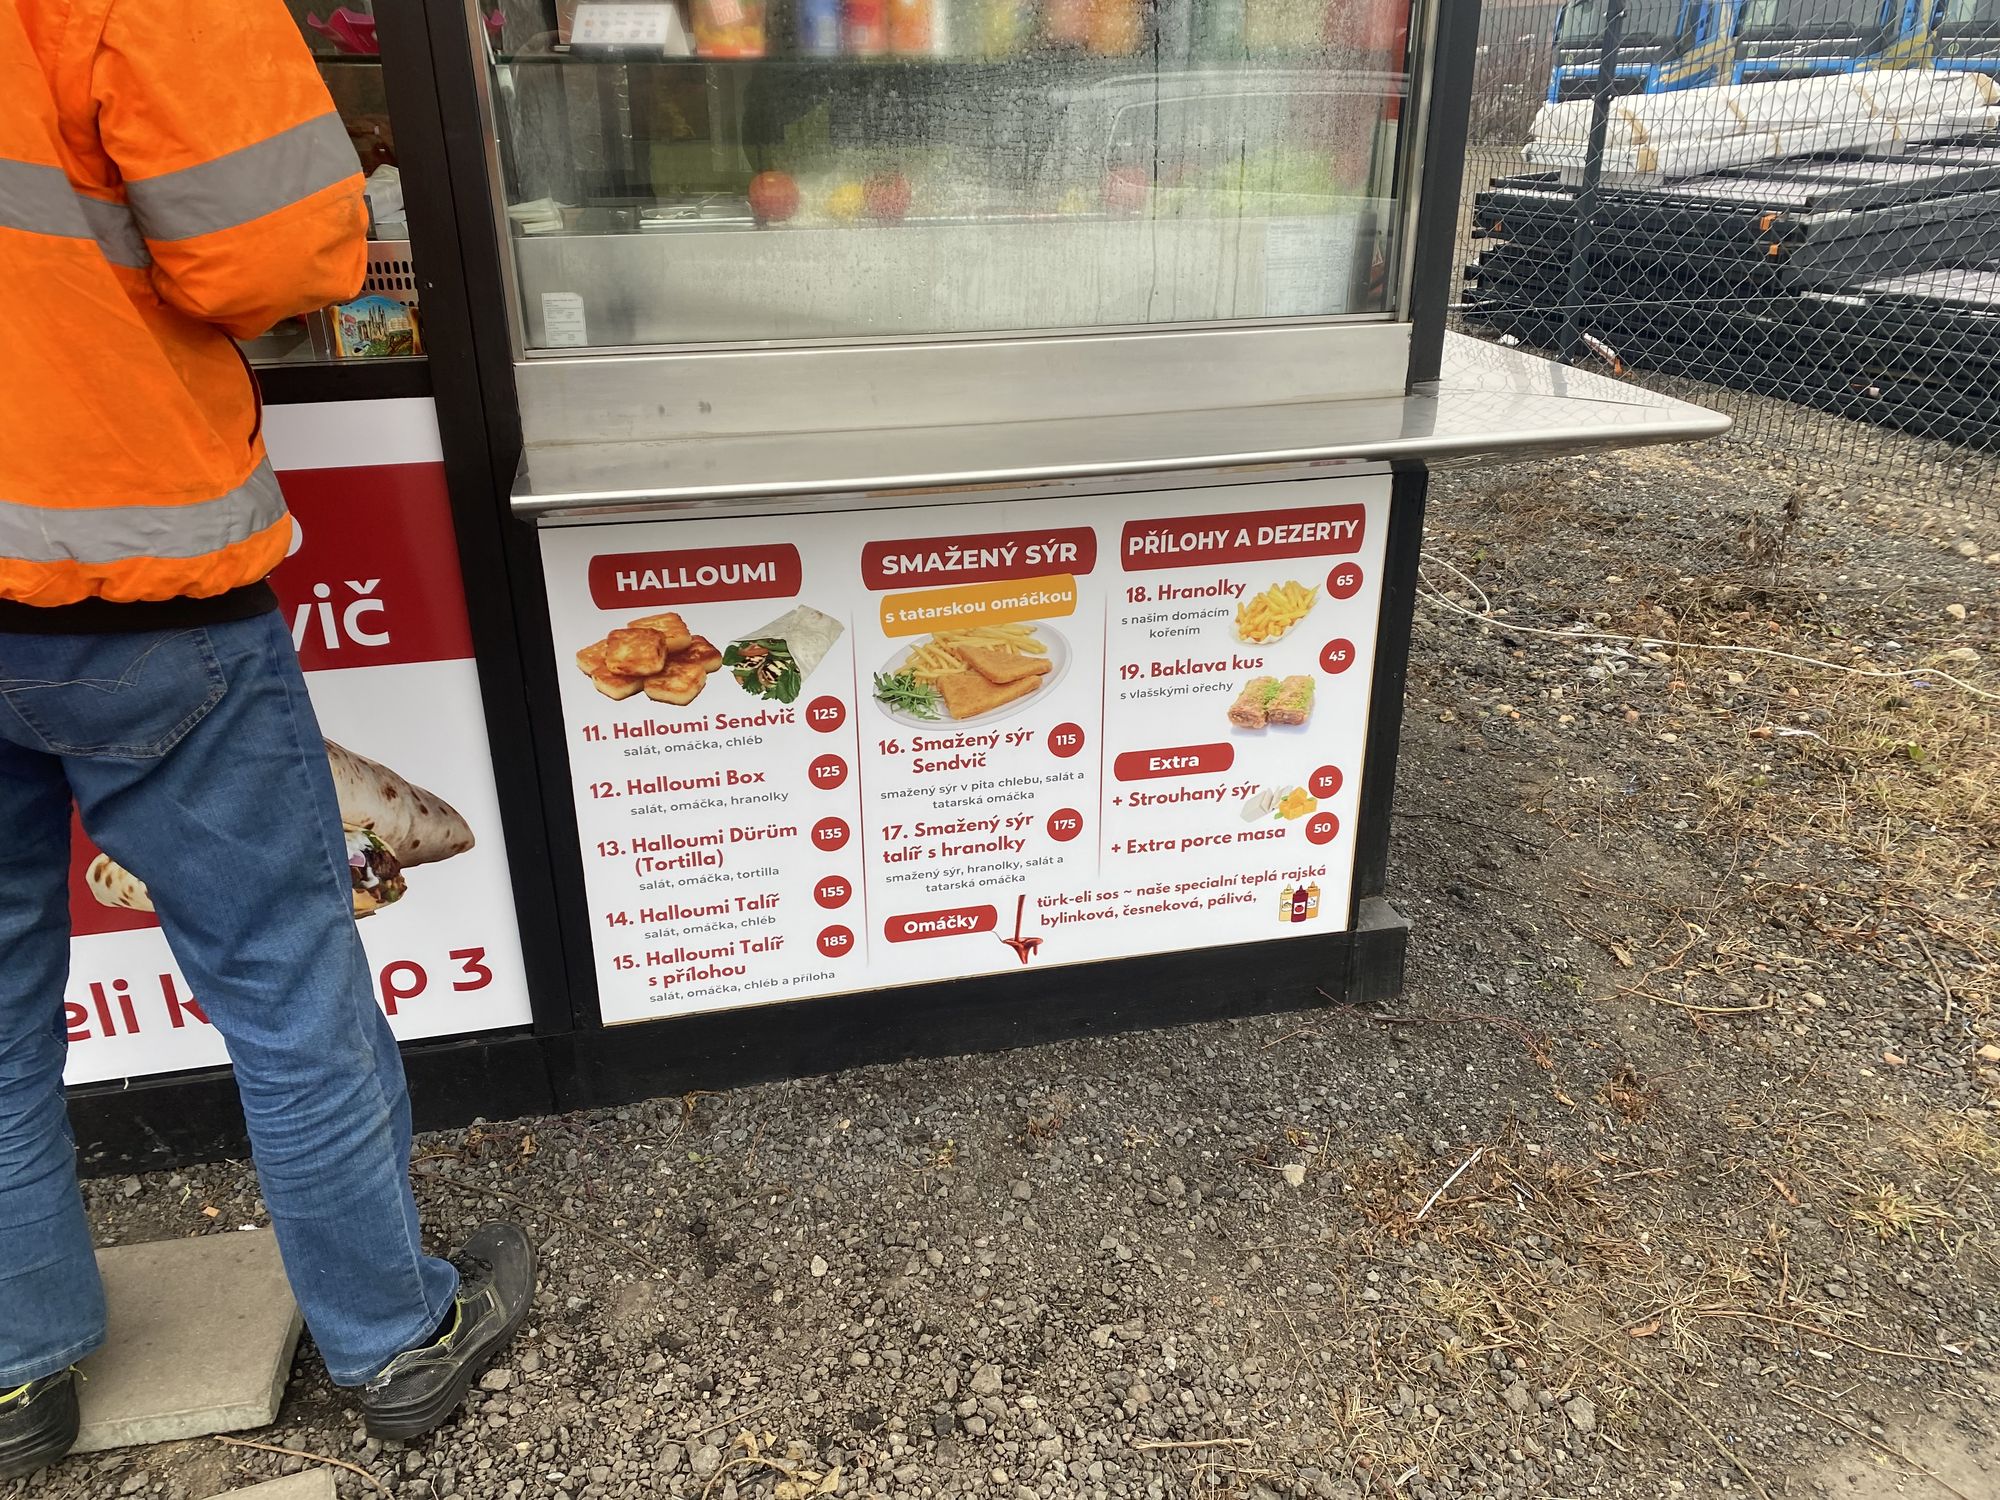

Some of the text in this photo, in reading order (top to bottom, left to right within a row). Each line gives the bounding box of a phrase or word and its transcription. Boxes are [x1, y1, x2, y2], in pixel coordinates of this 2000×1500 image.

[1128, 519, 1359, 556] PŘÍLOHY A DEZERTY
[882, 538, 1078, 575] SMAŽENÝ SÝR
[615, 561, 777, 592] HALLOUMI
[1336, 574, 1354, 586] 65
[1126, 578, 1247, 603] 18. Hranolky
[885, 591, 1072, 623] s tatarskou omáčkou
[1121, 607, 1229, 626] s našim domácím
[1149, 625, 1200, 639] kořením
[1119, 654, 1264, 680] 19. Baklava kus
[1329, 650, 1346, 662] 45
[1120, 681, 1233, 700] s vlašskými ořechy
[582, 707, 795, 742] 11. Halloumi Sendvič
[812, 707, 838, 721] 125
[623, 735, 763, 757] salát, omáčka, chléb
[878, 727, 1035, 755] 16. Smažený sýr
[1056, 734, 1077, 745] 115
[815, 765, 840, 778] 125
[911, 752, 987, 774] Sendvič
[1149, 755, 1200, 771] Extra
[589, 769, 766, 799] 12. Halloumi Box
[880, 785, 936, 800] smažený
[938, 782, 958, 795] sýr
[960, 783, 969, 791] v
[971, 780, 995, 793] pita
[998, 775, 1043, 788] chlebu,
[1045, 771, 1074, 783] salát
[1112, 780, 1260, 808] + Strouhaný sýr
[1318, 776, 1333, 787] 15
[630, 791, 789, 817] salát, omáčka, hranolky
[932, 791, 1035, 809] tatarská omáčka
[818, 827, 843, 840] 135
[882, 812, 1034, 841] 17. Smažený sýr
[1053, 818, 1076, 830] 175
[1314, 823, 1331, 834] 50
[596, 824, 797, 858] 13. Halloumi Dürüm
[882, 835, 1026, 864] talíř s hranolky
[1111, 826, 1286, 855] + Extra porce masa
[635, 849, 724, 877] (Tortilla)
[885, 869, 940, 884] smažený
[942, 864, 964, 877] sýr,
[967, 861, 1023, 874] hranolky,
[1025, 856, 1054, 867] salát
[639, 867, 780, 892] salát, omáčka, tortilla
[820, 885, 844, 898] 155
[925, 874, 1026, 893] tatarská omáčka
[1037, 890, 1093, 909] türk-eli
[1095, 889, 1120, 901] sos
[1136, 881, 1171, 897] naše
[1174, 875, 1238, 894] specialní
[1241, 870, 1278, 886] teplá
[1281, 865, 1326, 883] rajská
[605, 892, 780, 928] 14. Halloumi Talíř
[1040, 890, 1257, 928] bylinková, česneková, pálivá,
[644, 915, 776, 940] salát, omáčka, chléb
[903, 913, 979, 934] Omáčky
[612, 936, 785, 971] 15. Halloumi Talíř
[823, 935, 848, 947] 185
[448, 946, 493, 992] 3
[648, 963, 747, 989] s přílohou
[649, 991, 684, 1003] salát,
[687, 984, 742, 999] omáčka,
[744, 979, 779, 992] chléb
[792, 971, 836, 986] příloha
